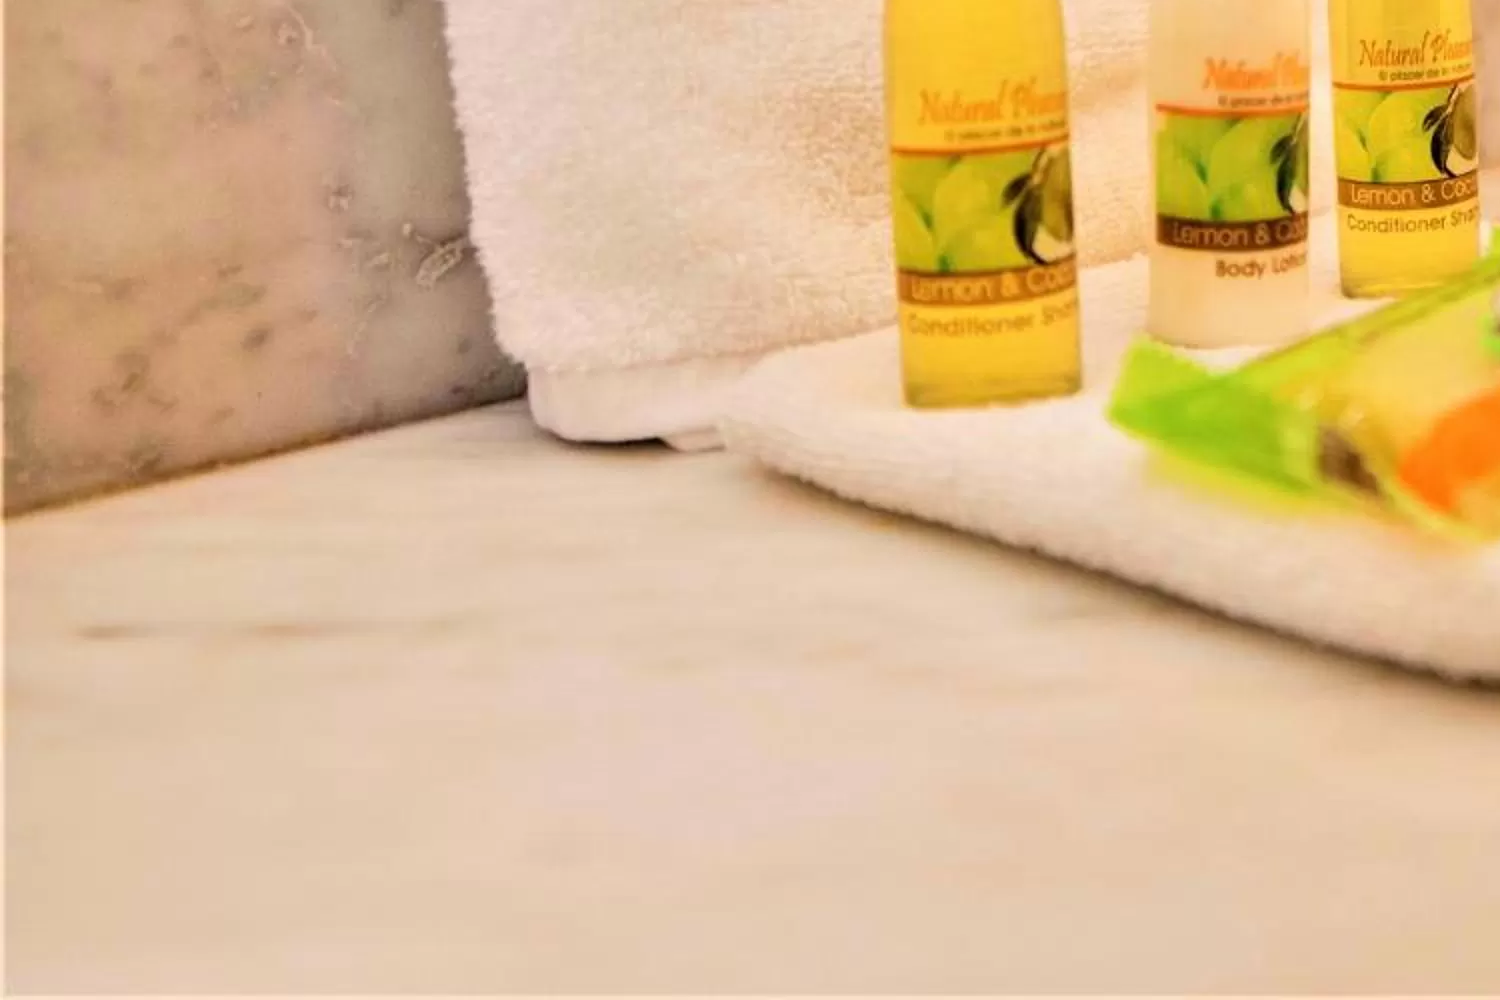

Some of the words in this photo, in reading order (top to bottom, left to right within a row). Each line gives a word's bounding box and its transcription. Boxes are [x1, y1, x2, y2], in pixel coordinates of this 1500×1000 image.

[1359, 29, 1430, 68] Natural
[1351, 183, 1417, 206] Lemon
[1421, 183, 1437, 204] &
[1172, 222, 1249, 248] Lemon
[1347, 214, 1446, 234] Conditioner
[1215, 259, 1266, 280] Body
[910, 274, 992, 301] Lemon
[906, 312, 1034, 339] Conditioner
